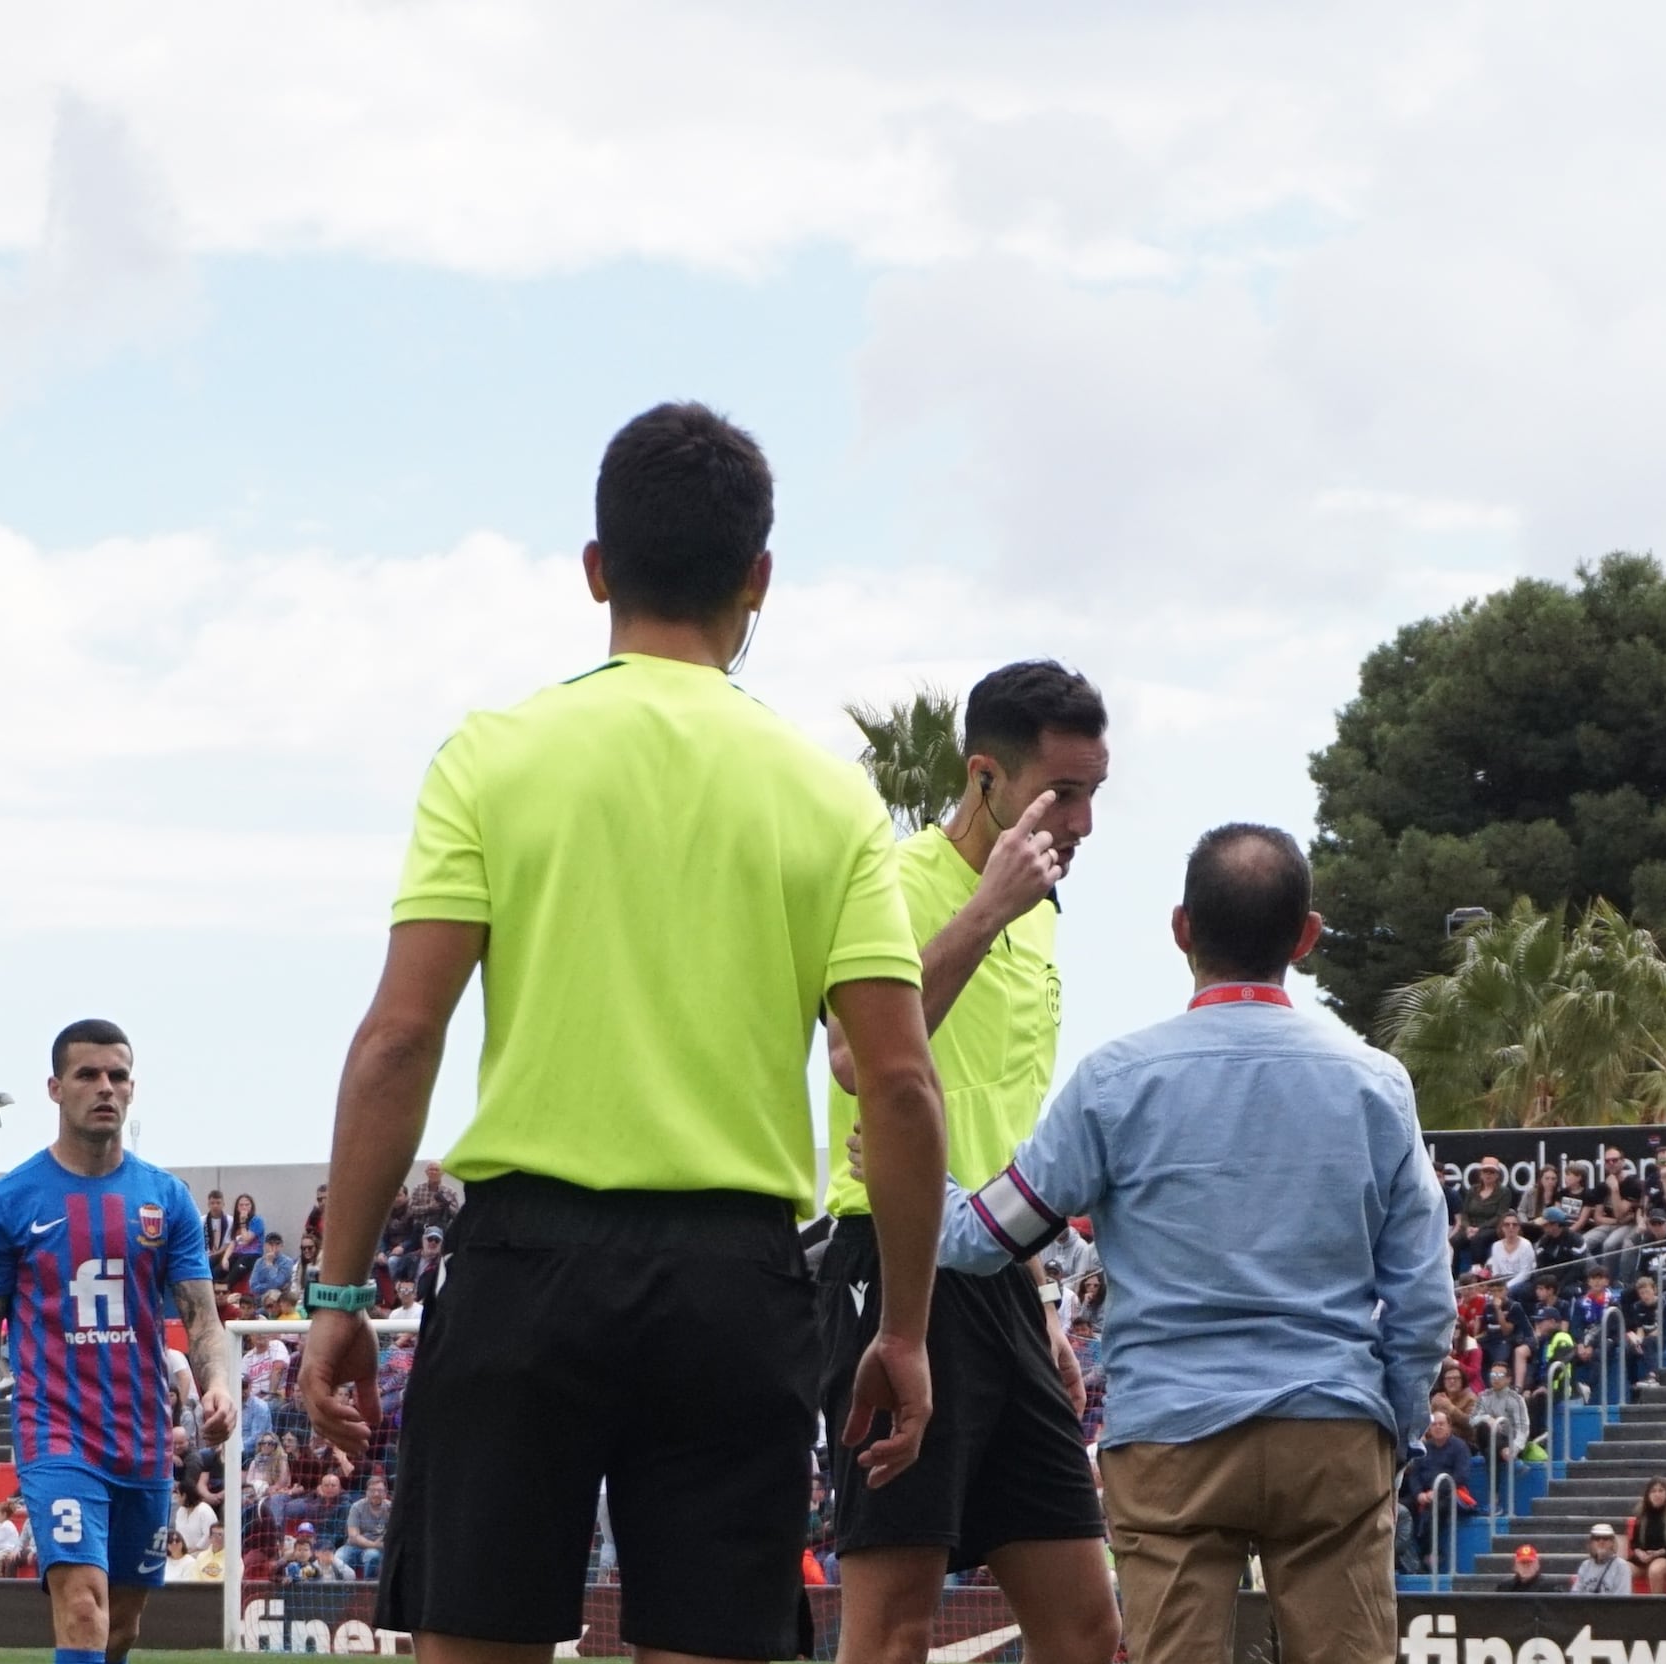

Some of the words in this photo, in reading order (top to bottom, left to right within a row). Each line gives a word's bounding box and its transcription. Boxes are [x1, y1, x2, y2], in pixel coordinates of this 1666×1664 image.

[69, 1259, 125, 1327] fi
[65, 1327, 137, 1344] network
[52, 1499, 82, 1543] 3
